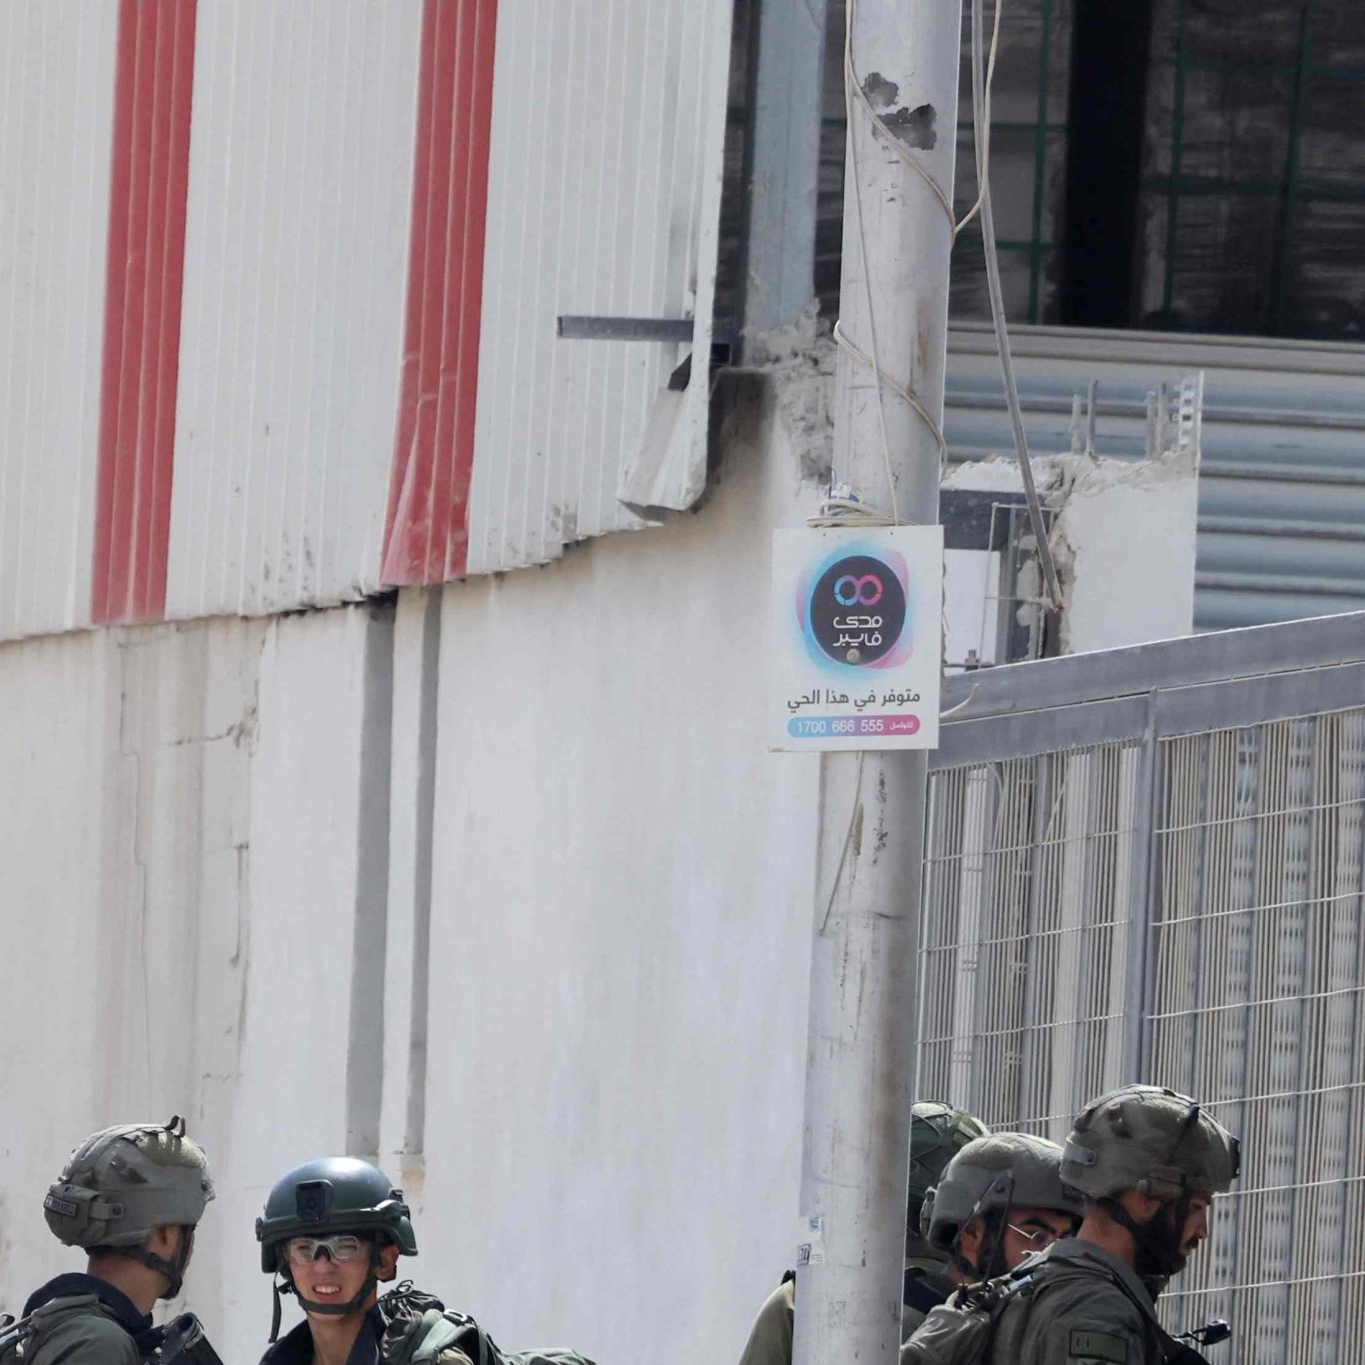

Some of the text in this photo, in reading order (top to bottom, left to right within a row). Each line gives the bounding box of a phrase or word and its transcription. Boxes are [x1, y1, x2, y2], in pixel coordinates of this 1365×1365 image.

[833, 616, 883, 629] مدى
[832, 631, 883, 647] فايبر
[787, 688, 921, 714] متوفر في هذا الحي
[796, 720, 827, 734] 1700
[831, 719, 855, 733] 666
[860, 719, 884, 732] 555
